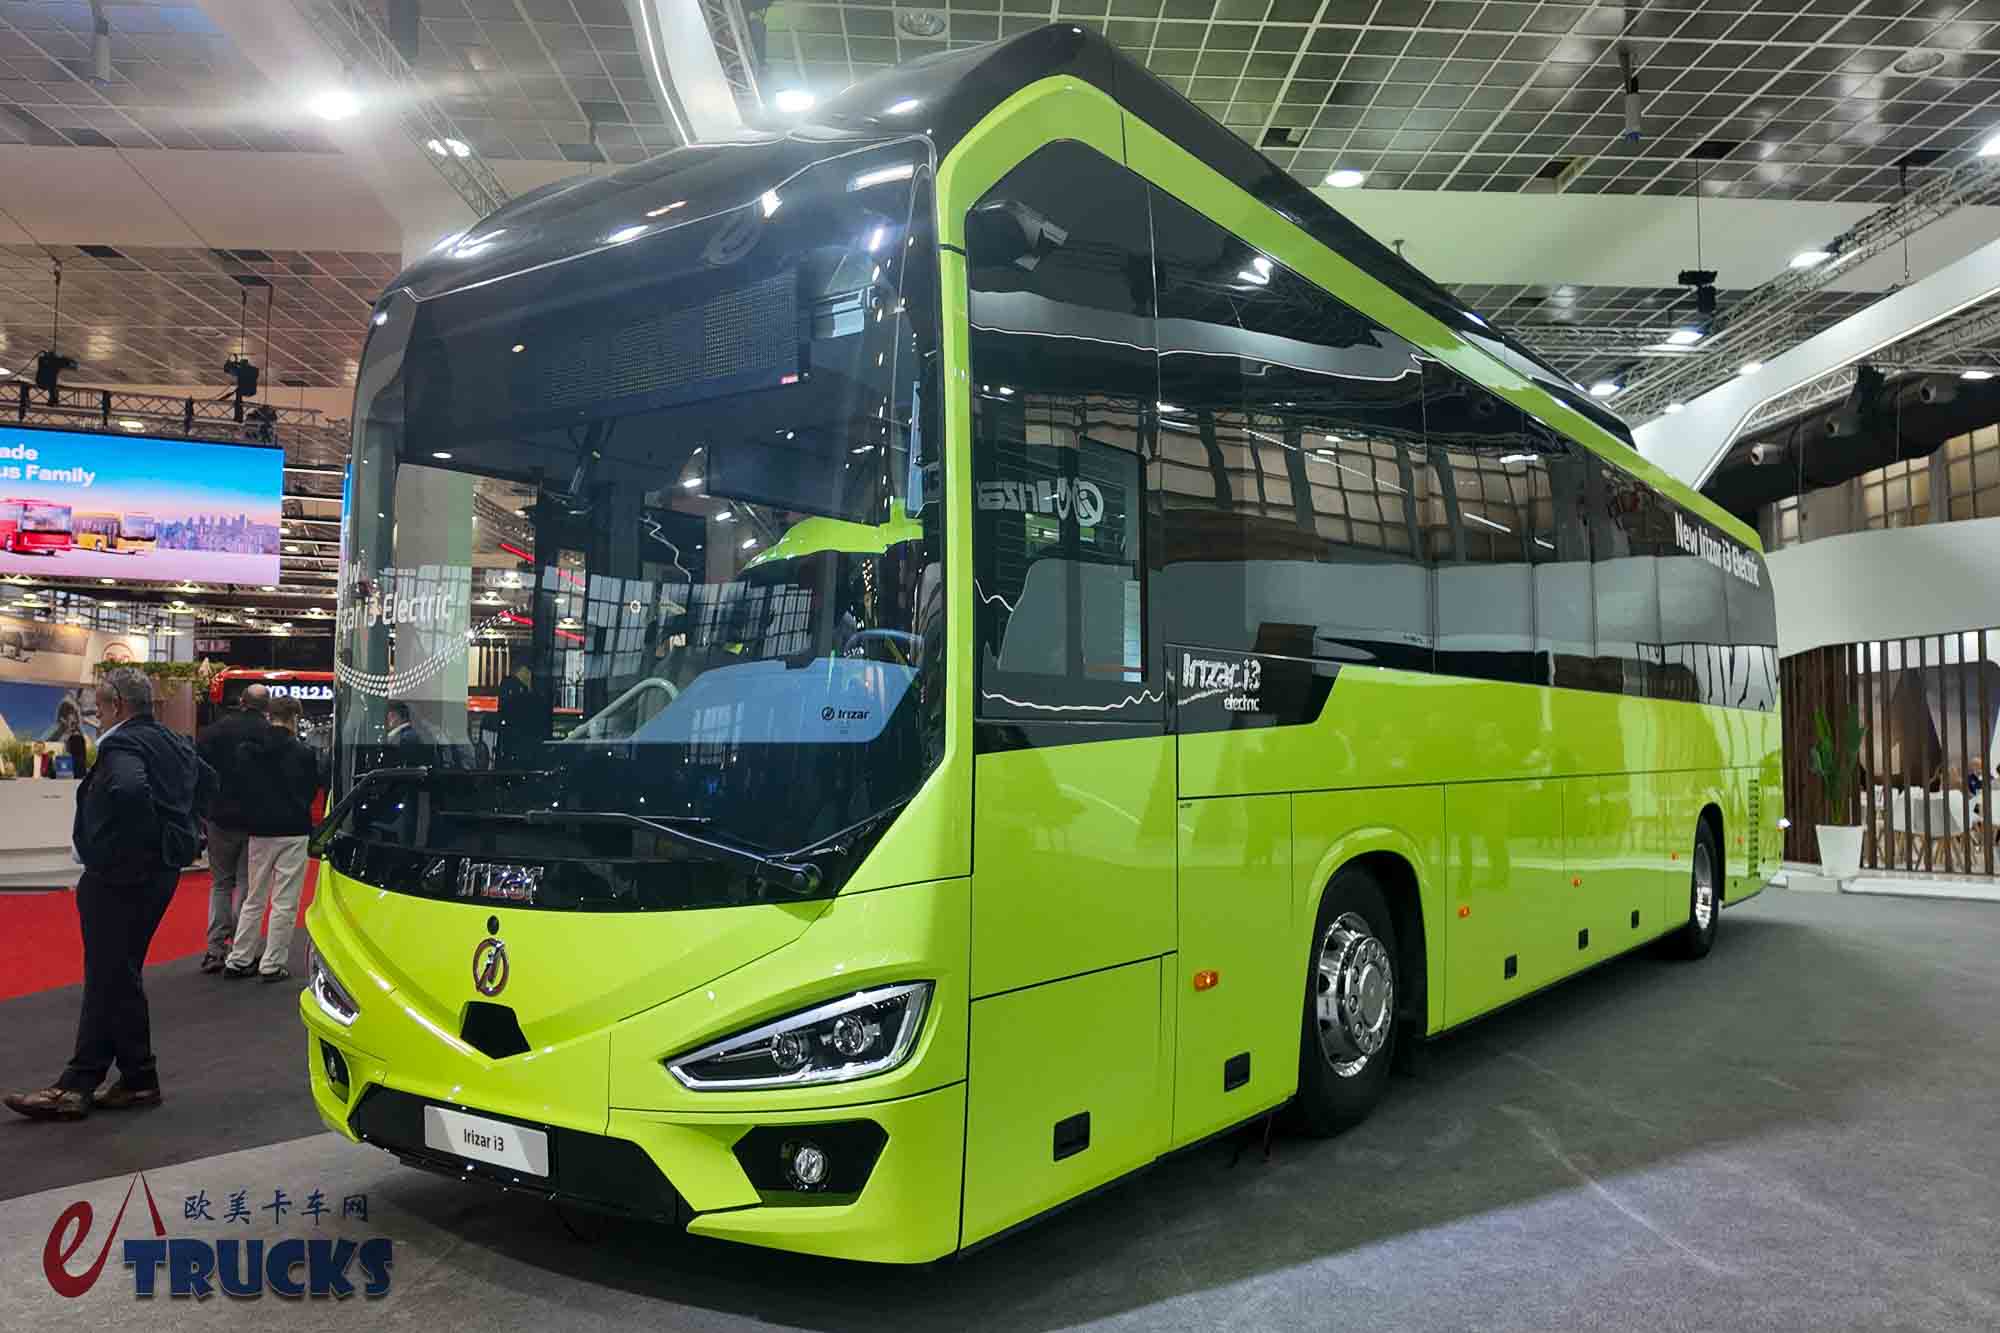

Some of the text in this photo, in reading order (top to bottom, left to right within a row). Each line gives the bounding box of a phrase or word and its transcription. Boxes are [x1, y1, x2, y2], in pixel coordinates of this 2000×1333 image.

[26, 464, 96, 488] Family
[1674, 511, 1760, 588] New Irizar i3 Electric
[382, 586, 452, 625] Electric
[1183, 653, 1261, 691] Irizar i3
[838, 709, 870, 719] Irizar
[1224, 694, 1260, 712] electric
[456, 858, 544, 904] Irizar
[464, 1128, 504, 1152] Irizar i3
